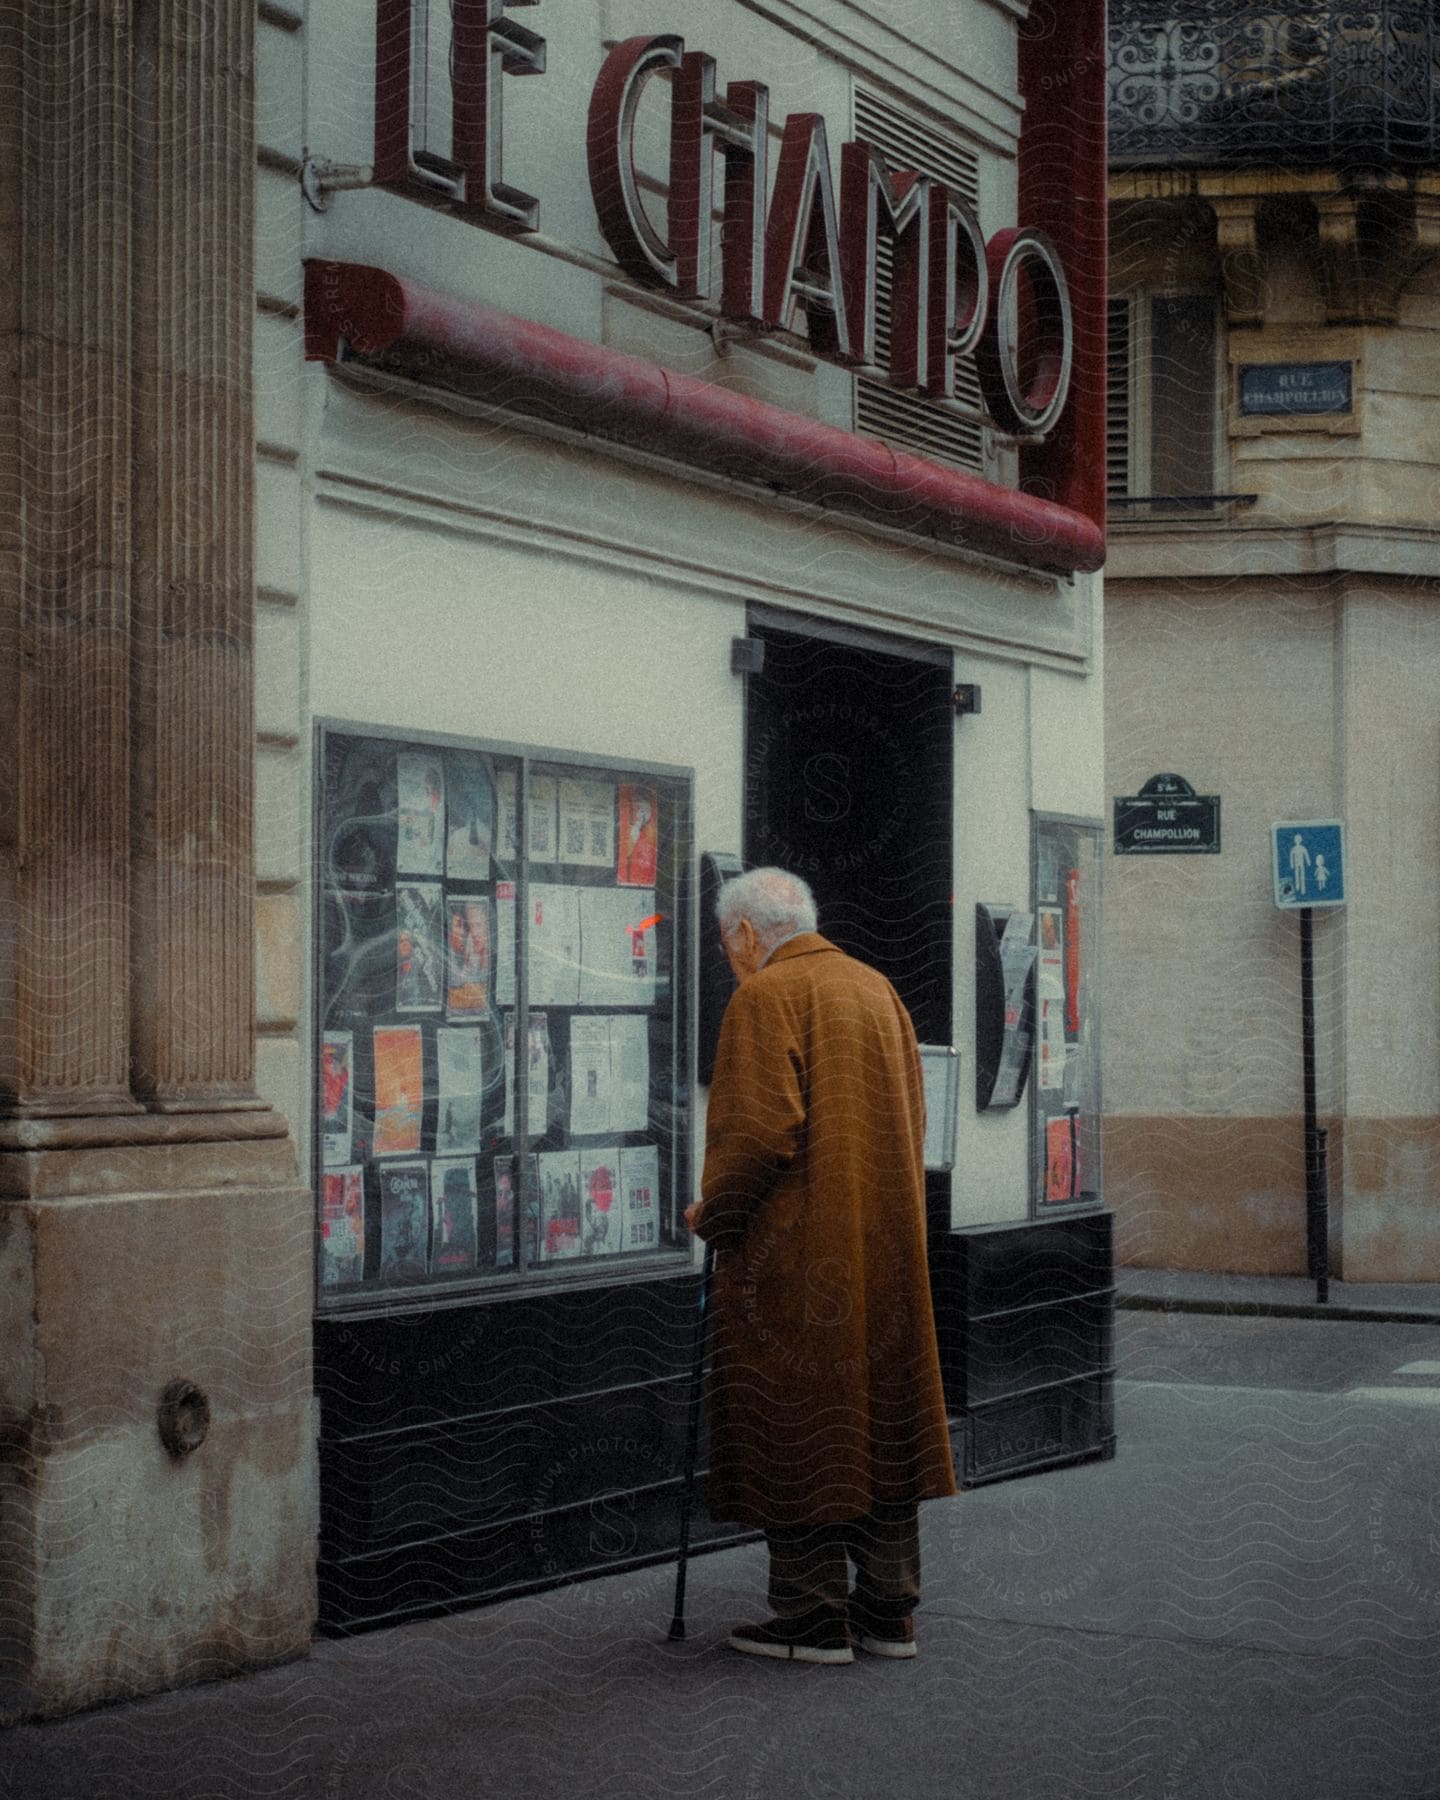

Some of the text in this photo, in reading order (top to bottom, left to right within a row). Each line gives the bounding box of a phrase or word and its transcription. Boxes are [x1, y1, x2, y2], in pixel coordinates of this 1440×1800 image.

[374, 0, 1073, 435] LE CHAMPO
[1279, 374, 1313, 387] RUE
[1157, 809, 1177, 821] RUE
[1133, 828, 1201, 840] CHAMPOLLION
